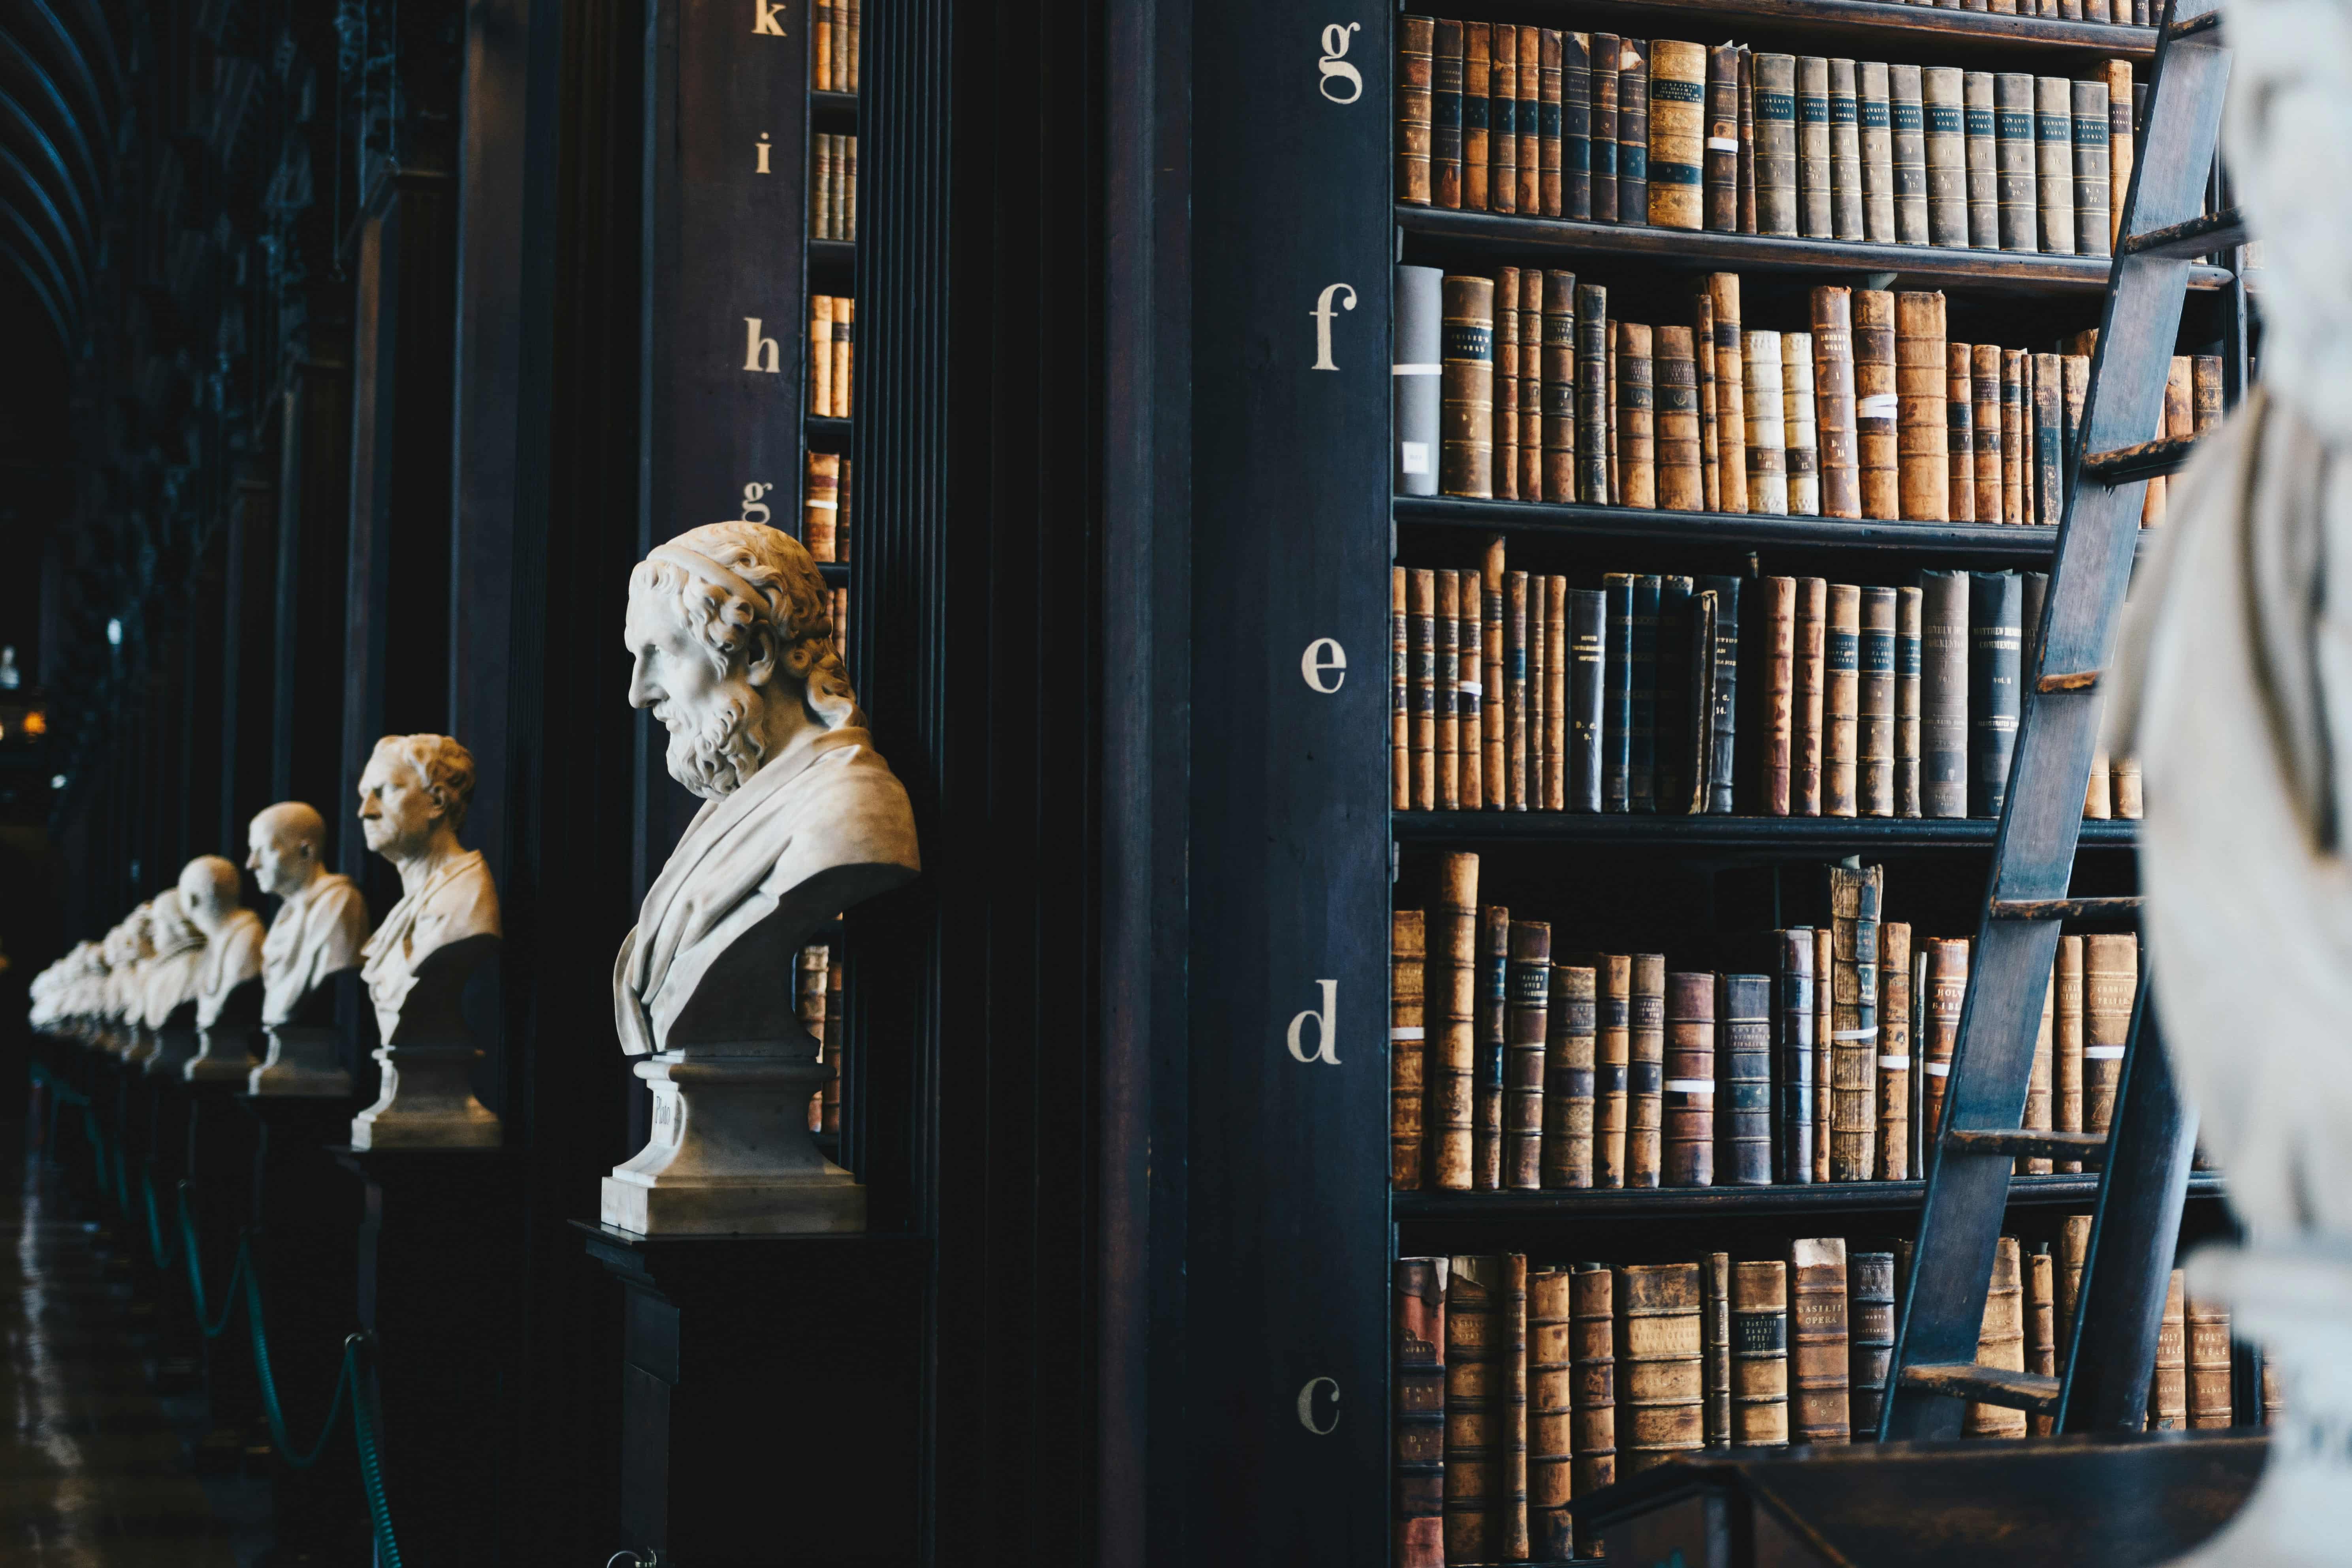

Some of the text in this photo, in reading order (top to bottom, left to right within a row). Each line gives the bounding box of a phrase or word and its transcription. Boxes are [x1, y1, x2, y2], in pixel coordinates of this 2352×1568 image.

[752, 0, 786, 36] k
[1318, 22, 1363, 104] g
[755, 132, 772, 173] i
[1309, 283, 1357, 371] f
[743, 317, 780, 373] h
[741, 482, 773, 525] g
[1979, 640, 2020, 650] COMMENTARY
[1301, 638, 1346, 693] e
[1932, 1002, 1960, 1011] BIBL
[1938, 989, 1962, 998] HOLY
[1287, 979, 1342, 1065] d
[655, 1096, 670, 1125] Plato
[1798, 1304, 1842, 1314] BASILII
[1805, 1316, 1837, 1325] OPERA
[2156, 1345, 2181, 1354] BIBLE
[2196, 1346, 2226, 1355] BIBLE
[2199, 1333, 2222, 1341] HOLY
[1297, 1376, 1340, 1435] c
